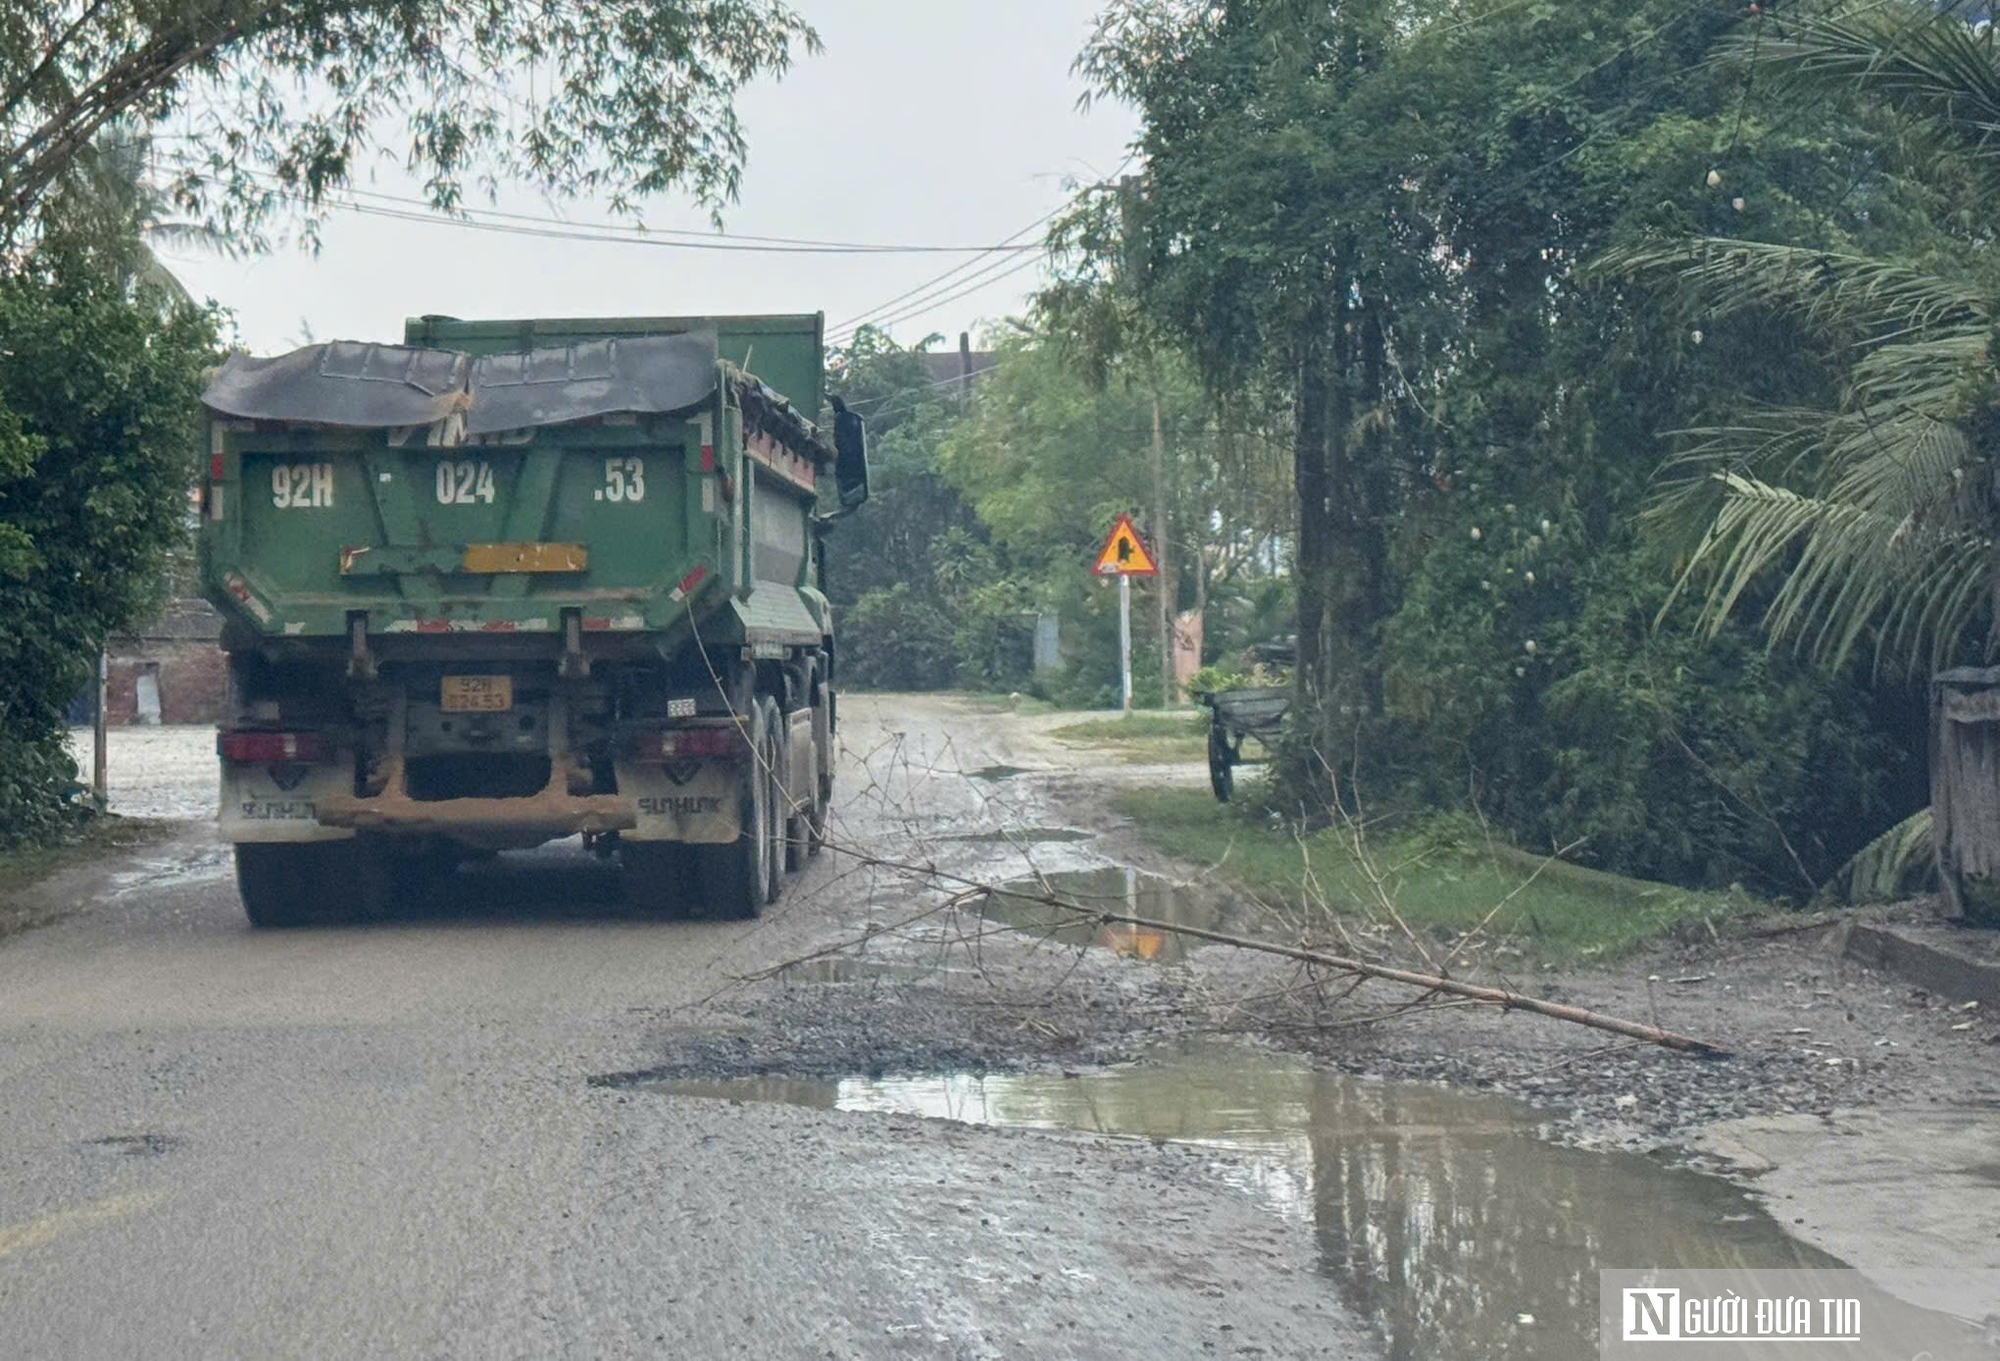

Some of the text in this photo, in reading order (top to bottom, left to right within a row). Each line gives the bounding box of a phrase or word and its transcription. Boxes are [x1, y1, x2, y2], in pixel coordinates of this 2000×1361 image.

[272, 457, 644, 508] 92H 024 .53
